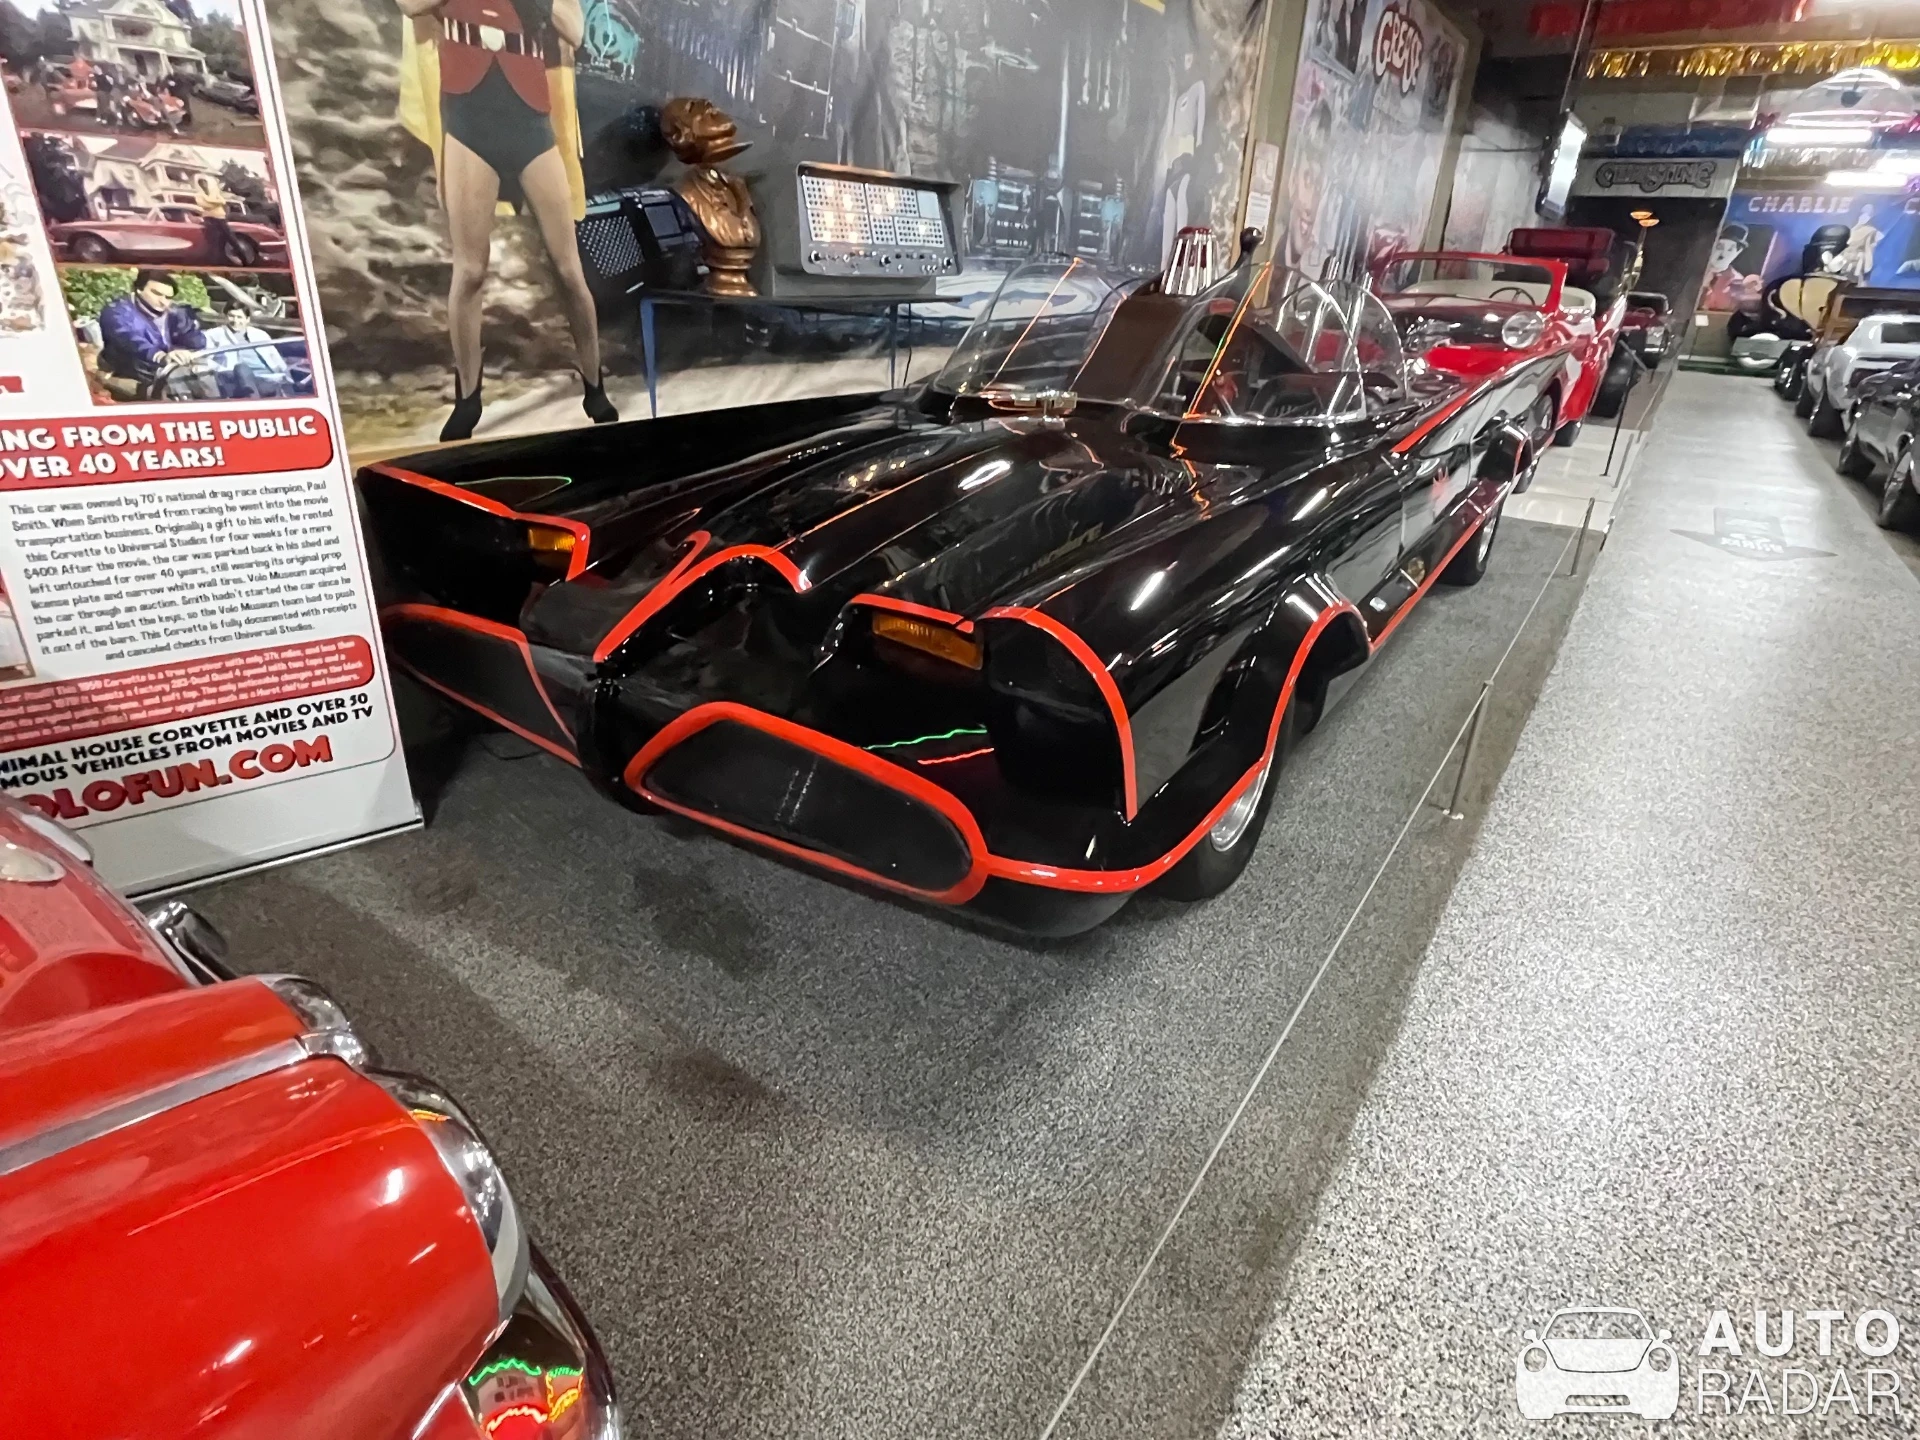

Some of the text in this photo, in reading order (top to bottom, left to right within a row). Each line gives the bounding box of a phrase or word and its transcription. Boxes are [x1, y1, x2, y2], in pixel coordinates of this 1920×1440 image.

[61, 422, 156, 448] FROM
[160, 420, 215, 442] THE
[220, 415, 319, 440] PUBLIC
[79, 451, 117, 475] 40
[121, 446, 226, 472] YEARS!
[9, 480, 327, 515] This car was owned by 70's national drag race champion, Paul
[12, 495, 329, 532] Smith. When Smith retired from racing he went into the movie
[16, 508, 334, 547] transportation business. Originally a gift to his wife, he rented
[26, 524, 332, 563] this Corvette to Universal Studios for four weeks for a mere
[29, 551, 342, 595] left untouched for over 40 years, still wearing its original prop
[61, 562, 94, 575] After
[96, 560, 115, 571] the
[117, 557, 151, 569] movie,
[153, 554, 170, 565] the
[172, 553, 189, 562] car
[192, 551, 213, 561] was
[214, 545, 250, 560] parked
[250, 543, 275, 554] back
[276, 542, 285, 552] in
[285, 540, 300, 551] his
[301, 537, 322, 549] shed
[324, 535, 341, 546] and
[33, 575, 352, 626] the car through an auction. Smith hadn't started the car since he
[72, 592, 101, 607] plate
[104, 589, 124, 600] and
[125, 586, 165, 598] narrow
[166, 581, 196, 594] white
[197, 578, 218, 589] wall
[220, 575, 247, 586] tires.
[247, 573, 268, 583] Volo
[269, 568, 308, 581] Museum
[309, 562, 347, 576] acquired
[36, 588, 356, 643] parked it, and lost the keys, so the Volo Museum team had to push
[40, 602, 358, 656] it out of the barn. This Corvette is fully documented with receipts
[105, 622, 316, 661] and canceled checks from Universal Studios.
[71, 734, 145, 760] HOUSE
[148, 714, 250, 745] CORVETTE
[252, 706, 294, 725] AND
[296, 696, 347, 716] OVER
[349, 692, 369, 708] 50
[71, 746, 172, 775] VEHICLES
[174, 732, 233, 756] FROM
[236, 718, 308, 744] MOVIES
[311, 710, 350, 730] AND
[349, 704, 374, 721] TV
